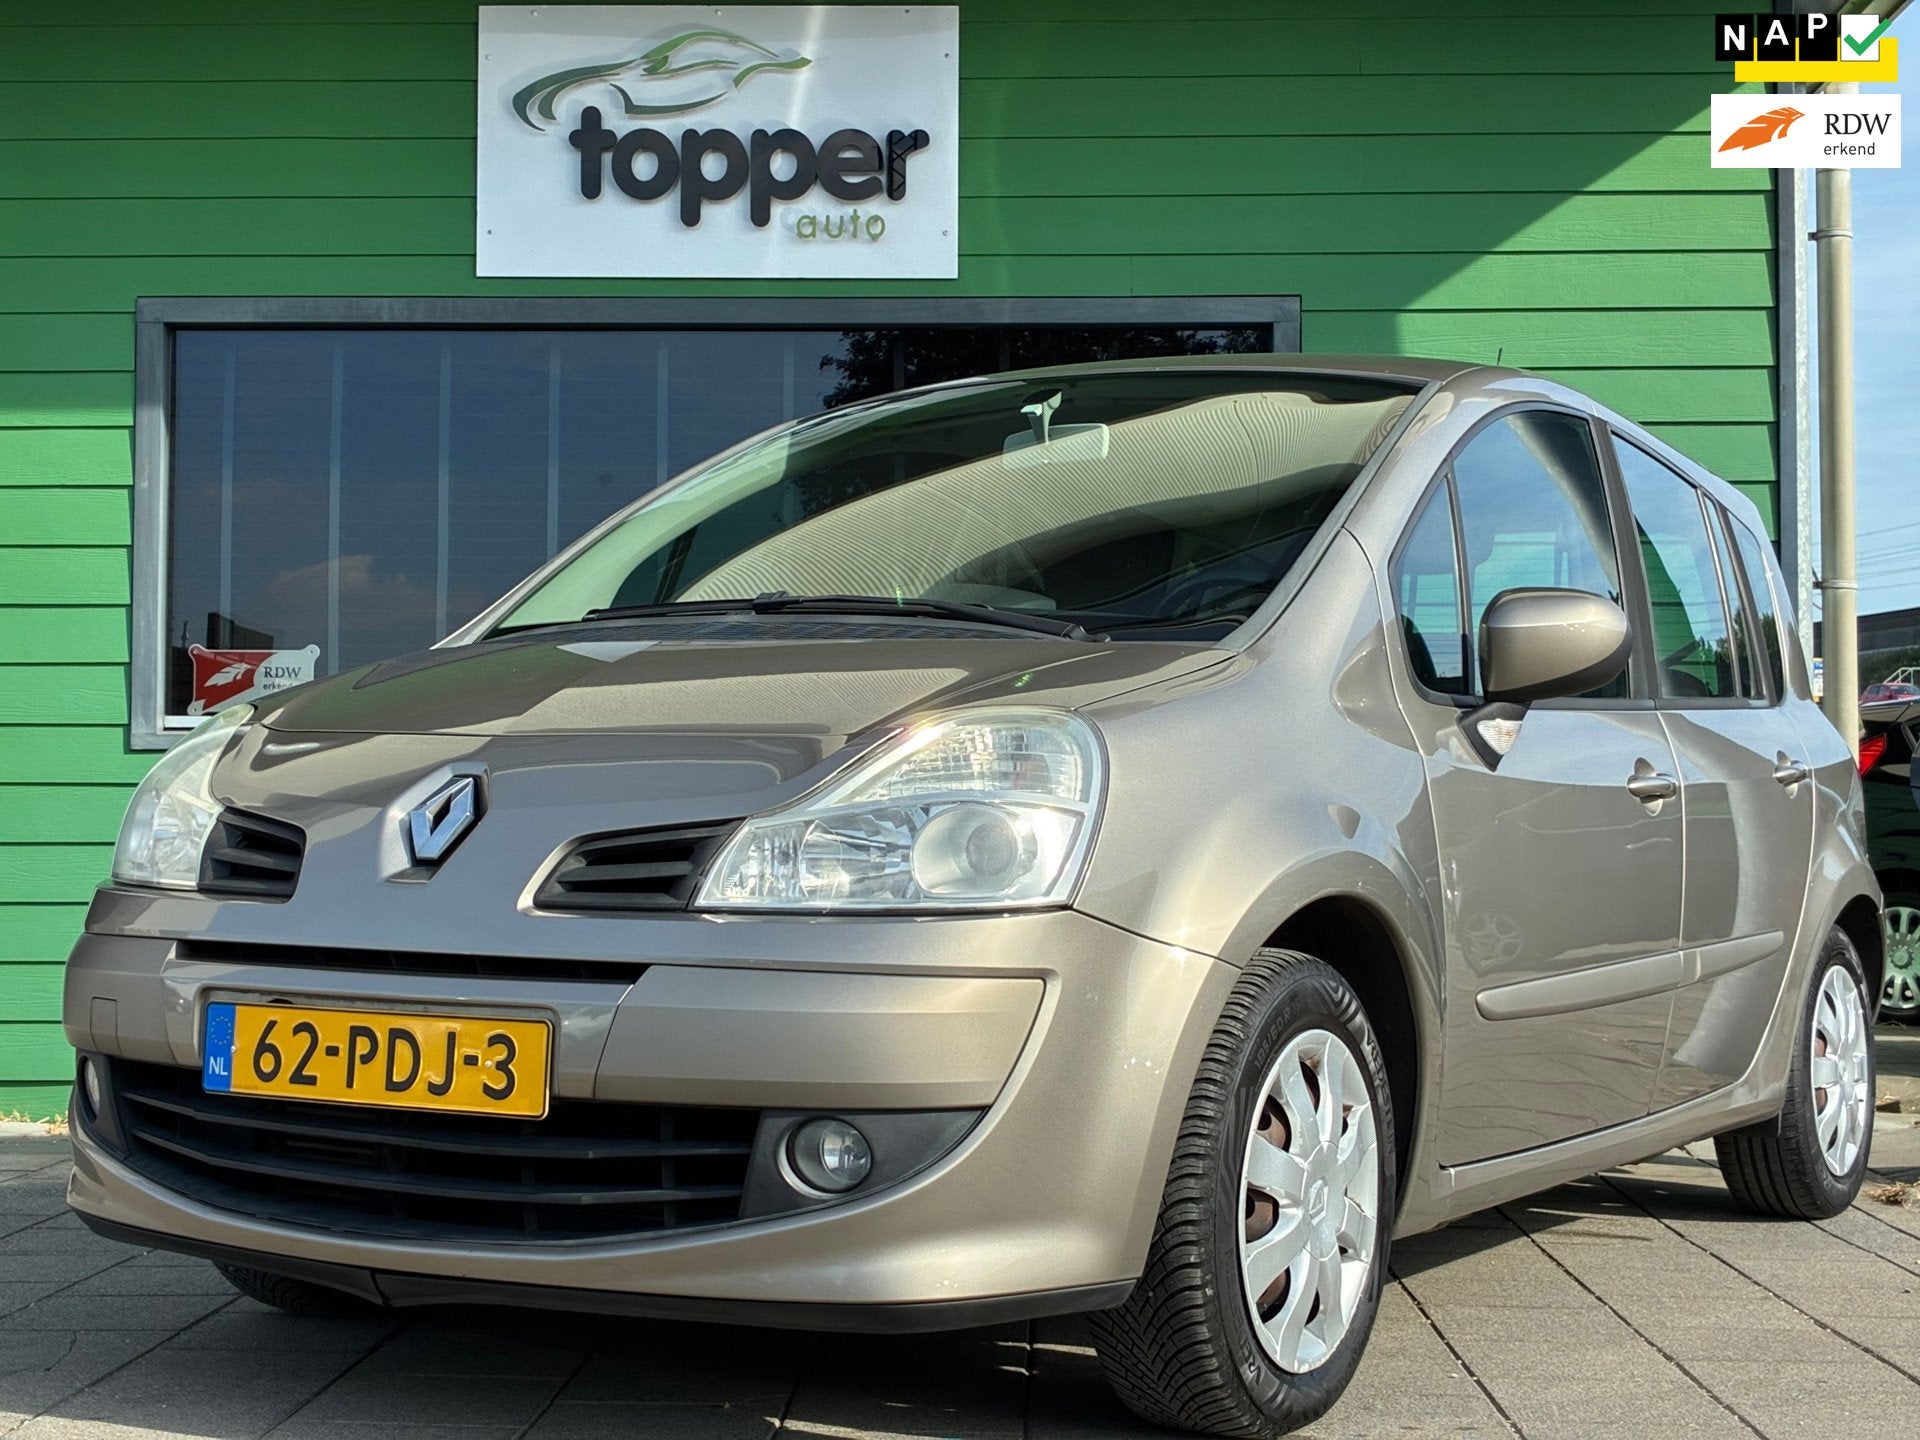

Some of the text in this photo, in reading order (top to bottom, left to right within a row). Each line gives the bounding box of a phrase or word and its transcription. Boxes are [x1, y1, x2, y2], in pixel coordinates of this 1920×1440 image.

[568, 106, 930, 228] topper
[796, 209, 886, 241] auto
[263, 666, 302, 679] RDW
[208, 1055, 228, 1077] NL
[253, 1019, 518, 1100] 62-PDJ-3
